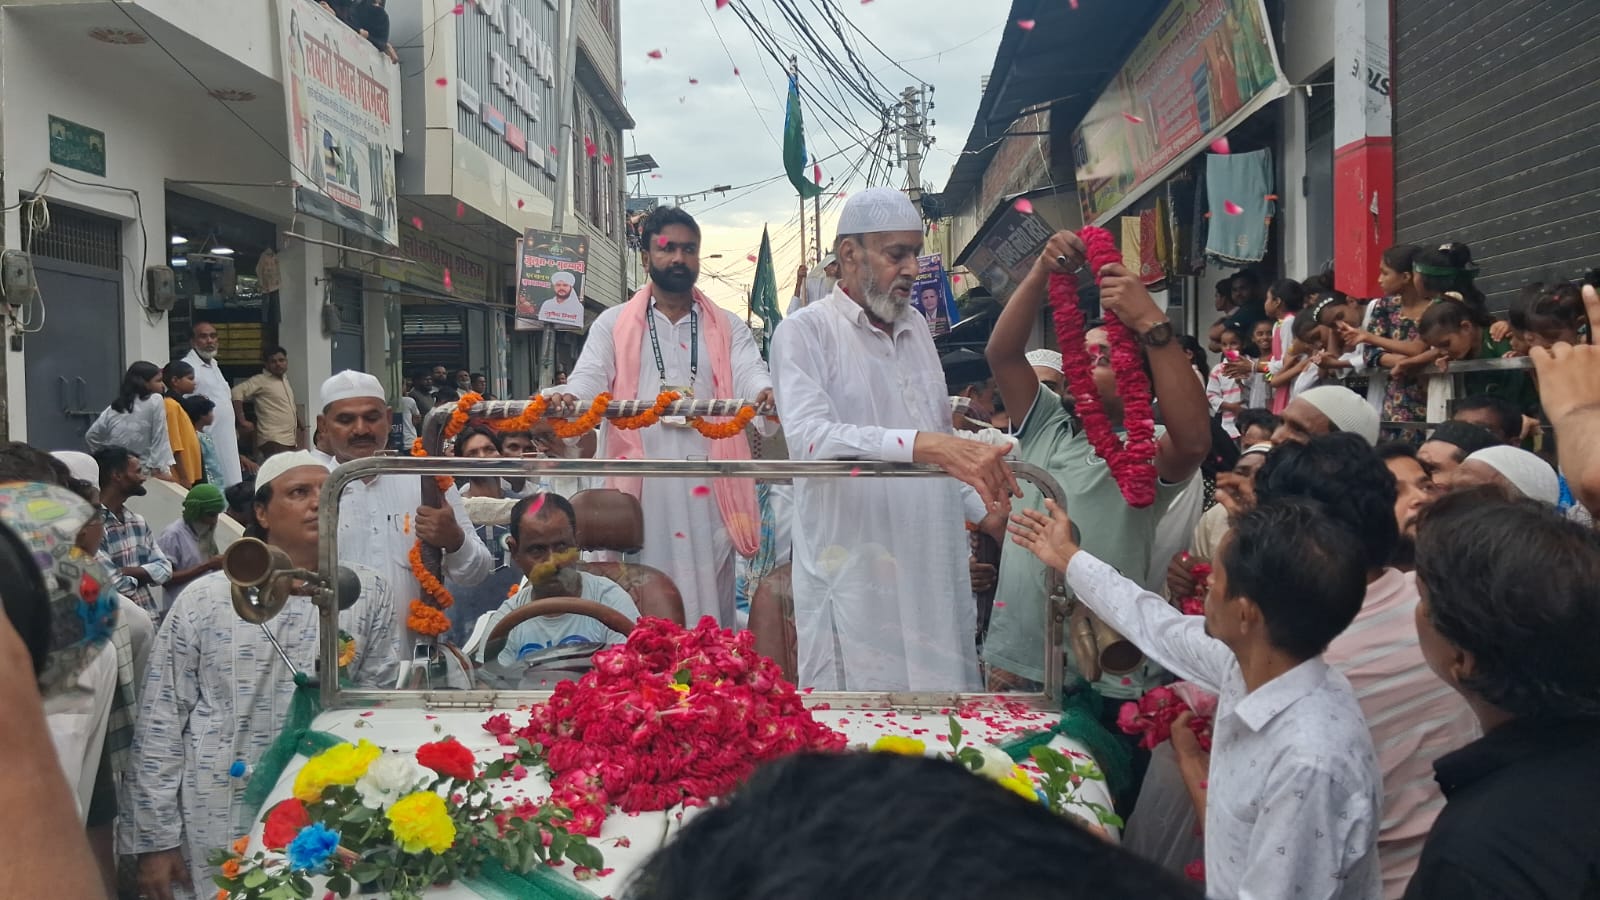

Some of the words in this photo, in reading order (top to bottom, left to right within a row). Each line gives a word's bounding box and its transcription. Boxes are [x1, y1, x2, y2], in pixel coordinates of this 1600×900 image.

[303, 31, 334, 89] लवली
[333, 40, 357, 104] फैशन
[509, 4, 555, 88] PRIYA
[490, 52, 541, 122] TEXTILE
